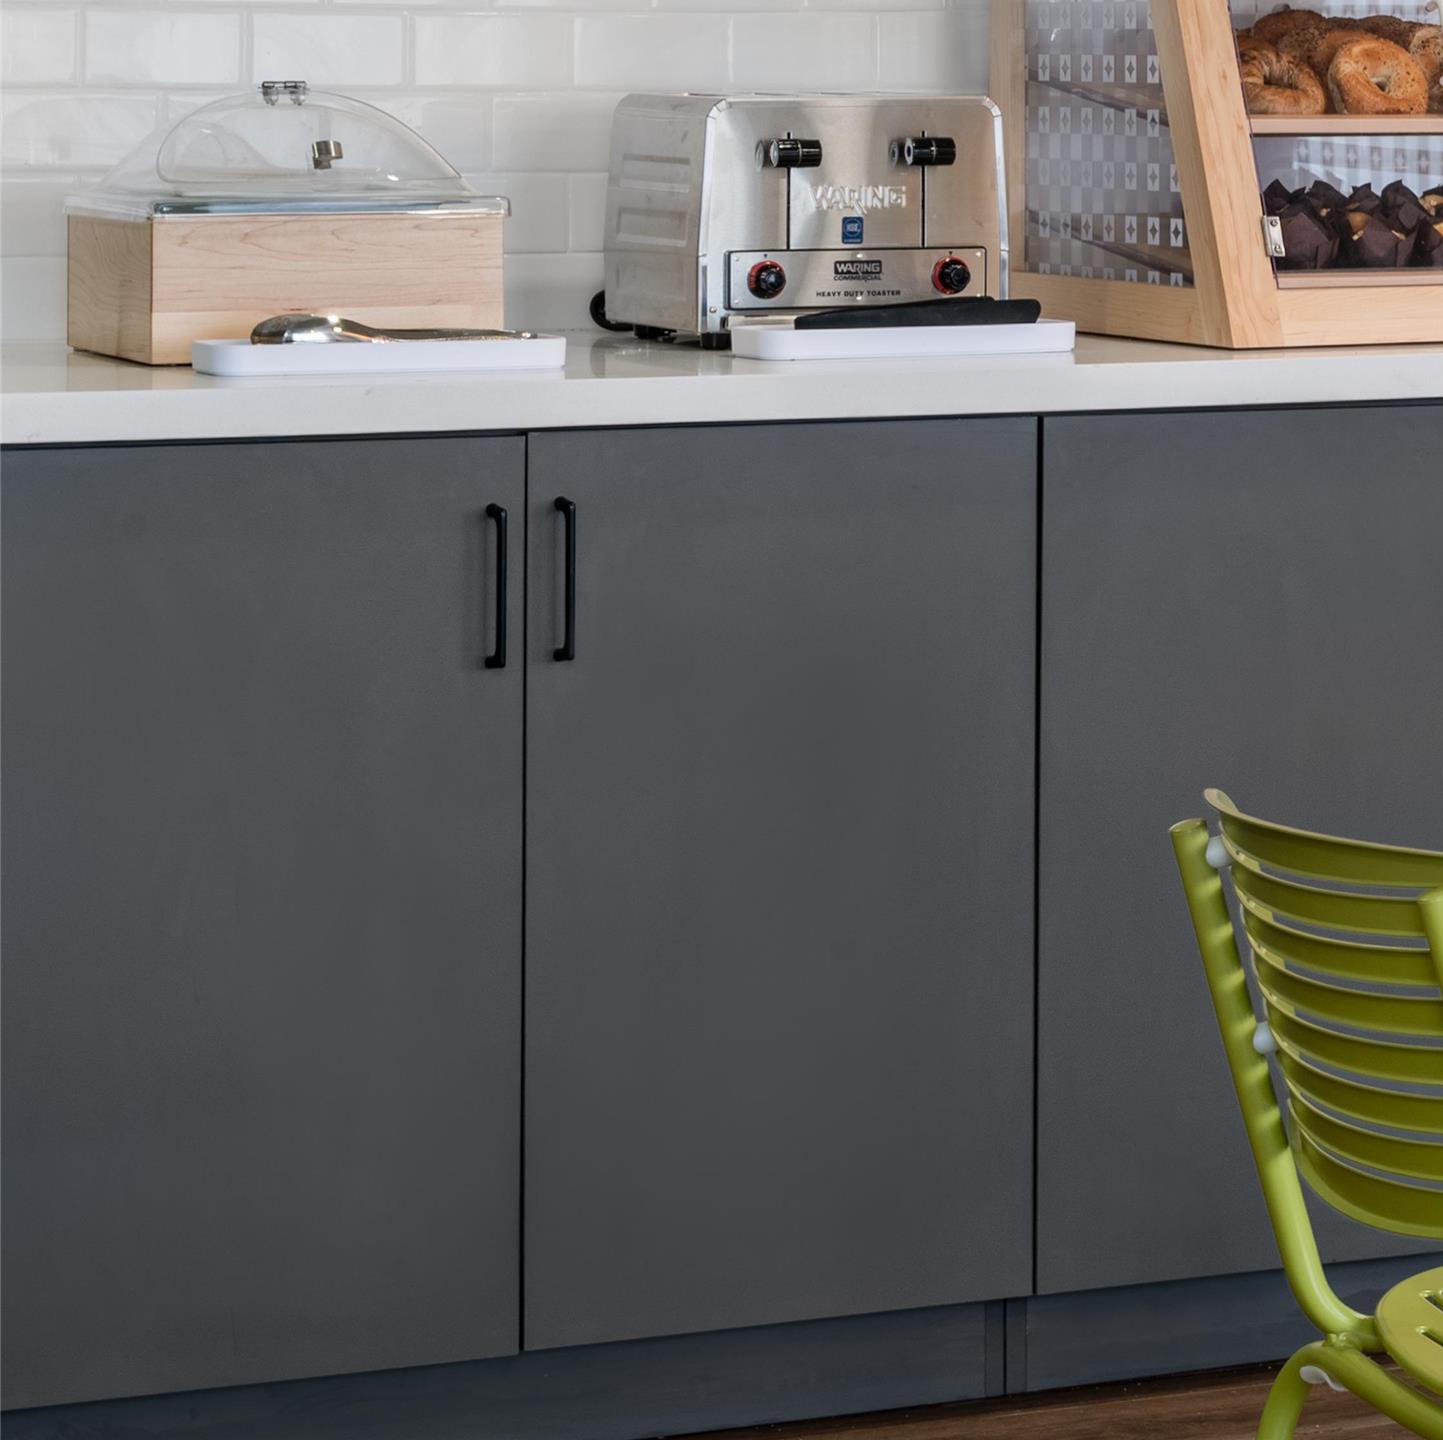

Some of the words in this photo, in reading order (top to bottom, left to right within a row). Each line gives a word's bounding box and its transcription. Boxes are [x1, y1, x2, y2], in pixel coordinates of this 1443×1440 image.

[808, 185, 906, 215] WARING
[836, 262, 881, 275] WARING
[833, 274, 882, 282] COMMERCIAL
